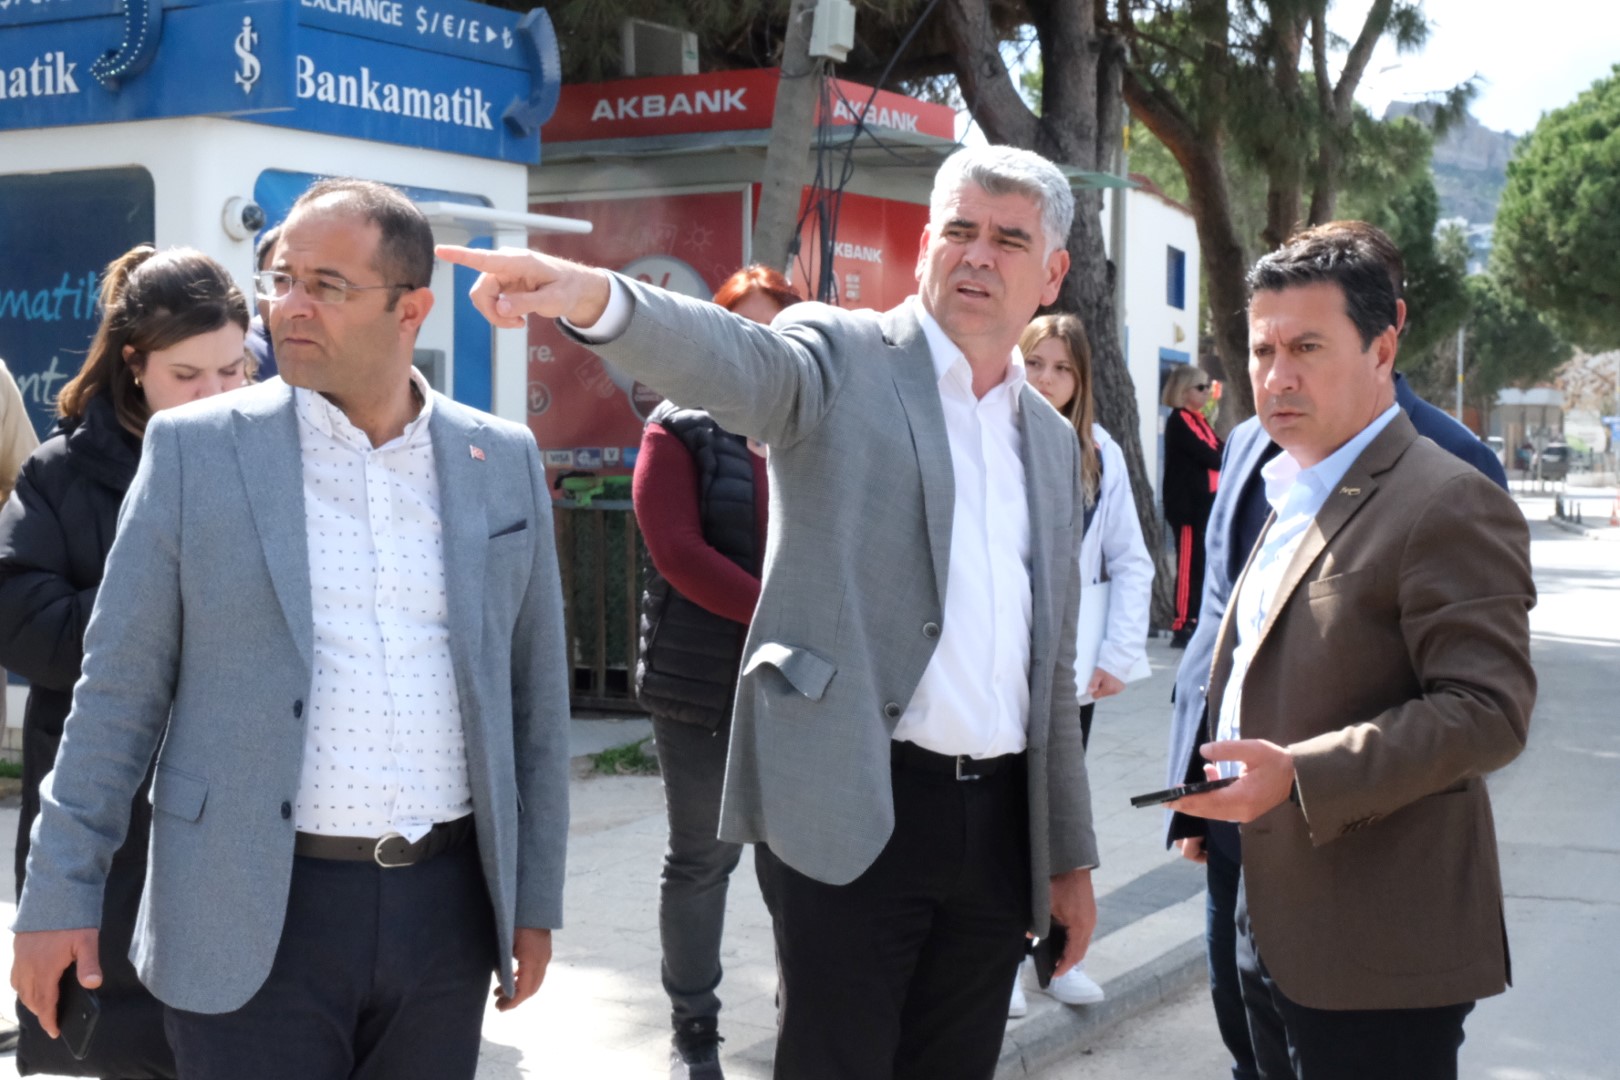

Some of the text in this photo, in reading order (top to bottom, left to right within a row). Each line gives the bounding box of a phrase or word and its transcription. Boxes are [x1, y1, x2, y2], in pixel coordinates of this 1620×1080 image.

[301, 0, 403, 26] CHANGE
[0, 51, 80, 99] atik
[296, 54, 494, 130] Bankamatik
[591, 87, 747, 121] AKBANK
[833, 98, 918, 133] AKBANK
